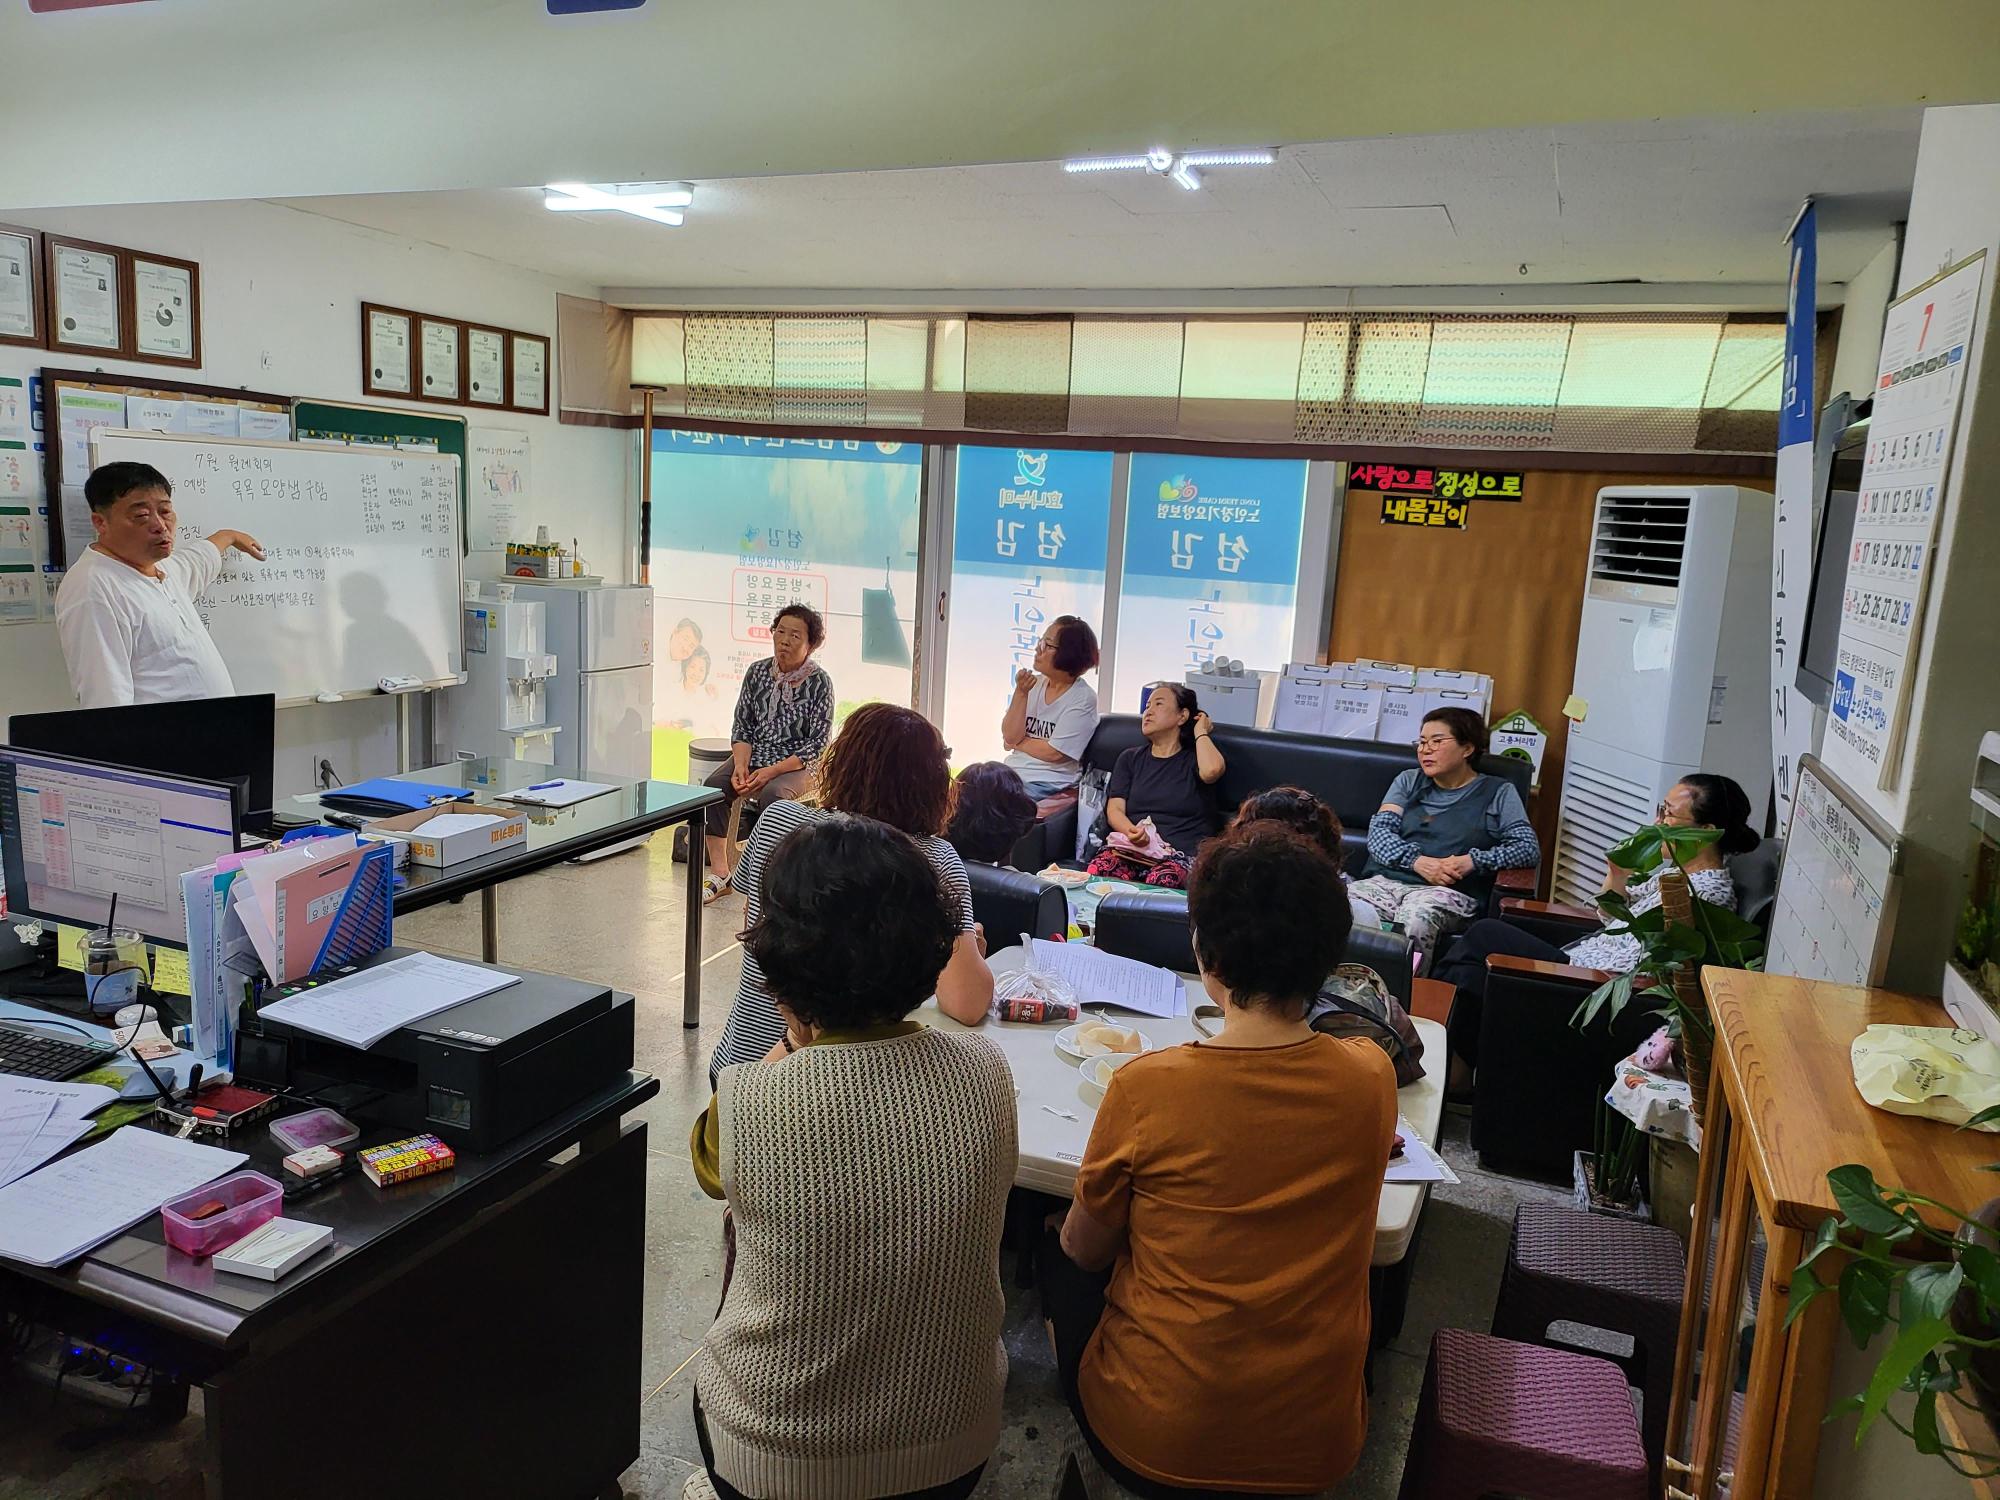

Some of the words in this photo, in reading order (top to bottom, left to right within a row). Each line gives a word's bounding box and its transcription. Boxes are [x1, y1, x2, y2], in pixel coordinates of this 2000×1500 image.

[1918, 303, 1934, 352] 7
[1869, 443, 1876, 464] 2
[1880, 441, 1886, 463] 3
[1891, 440, 1897, 460] 4
[1902, 437, 1909, 460] 5
[1914, 434, 1921, 458] 6
[1350, 465, 1435, 490] 사랑으로
[1436, 471, 1522, 498] 정성으로
[1385, 498, 1467, 526] 내몸같이
[1871, 492, 1878, 513] 10
[1882, 491, 1890, 513] 11
[1892, 490, 1901, 513] 12
[1902, 490, 1911, 513] 13
[1913, 488, 1923, 512] 14
[1923, 487, 1934, 512] 15
[1862, 542, 1871, 563] 17
[1872, 543, 1880, 565] 18
[1882, 544, 1890, 566] 19
[1891, 544, 1901, 567] 20
[1902, 545, 1912, 568] 21
[1912, 545, 1922, 569] 22
[1861, 594, 1871, 615] 25
[1871, 596, 1882, 618] 26
[1881, 598, 1892, 620] 27
[1891, 600, 1901, 624] 28
[1900, 602, 1911, 626] 29
